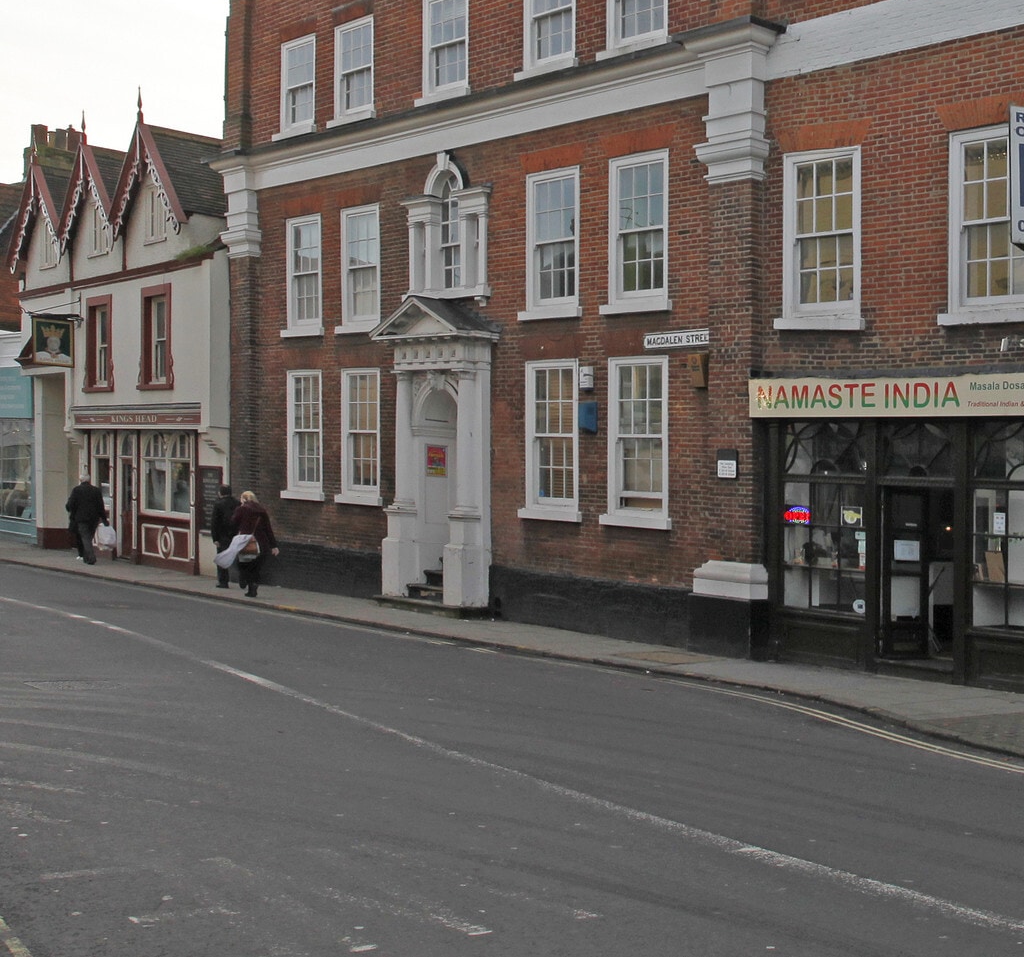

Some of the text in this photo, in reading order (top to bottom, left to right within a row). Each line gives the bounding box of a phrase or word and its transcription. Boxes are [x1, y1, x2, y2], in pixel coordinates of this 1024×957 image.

[647, 335, 683, 346] MAGDALEN
[969, 380, 1000, 391] Masala
[757, 381, 961, 410] NAMASTE INDIA
[111, 415, 157, 423] KINGS HEAD
